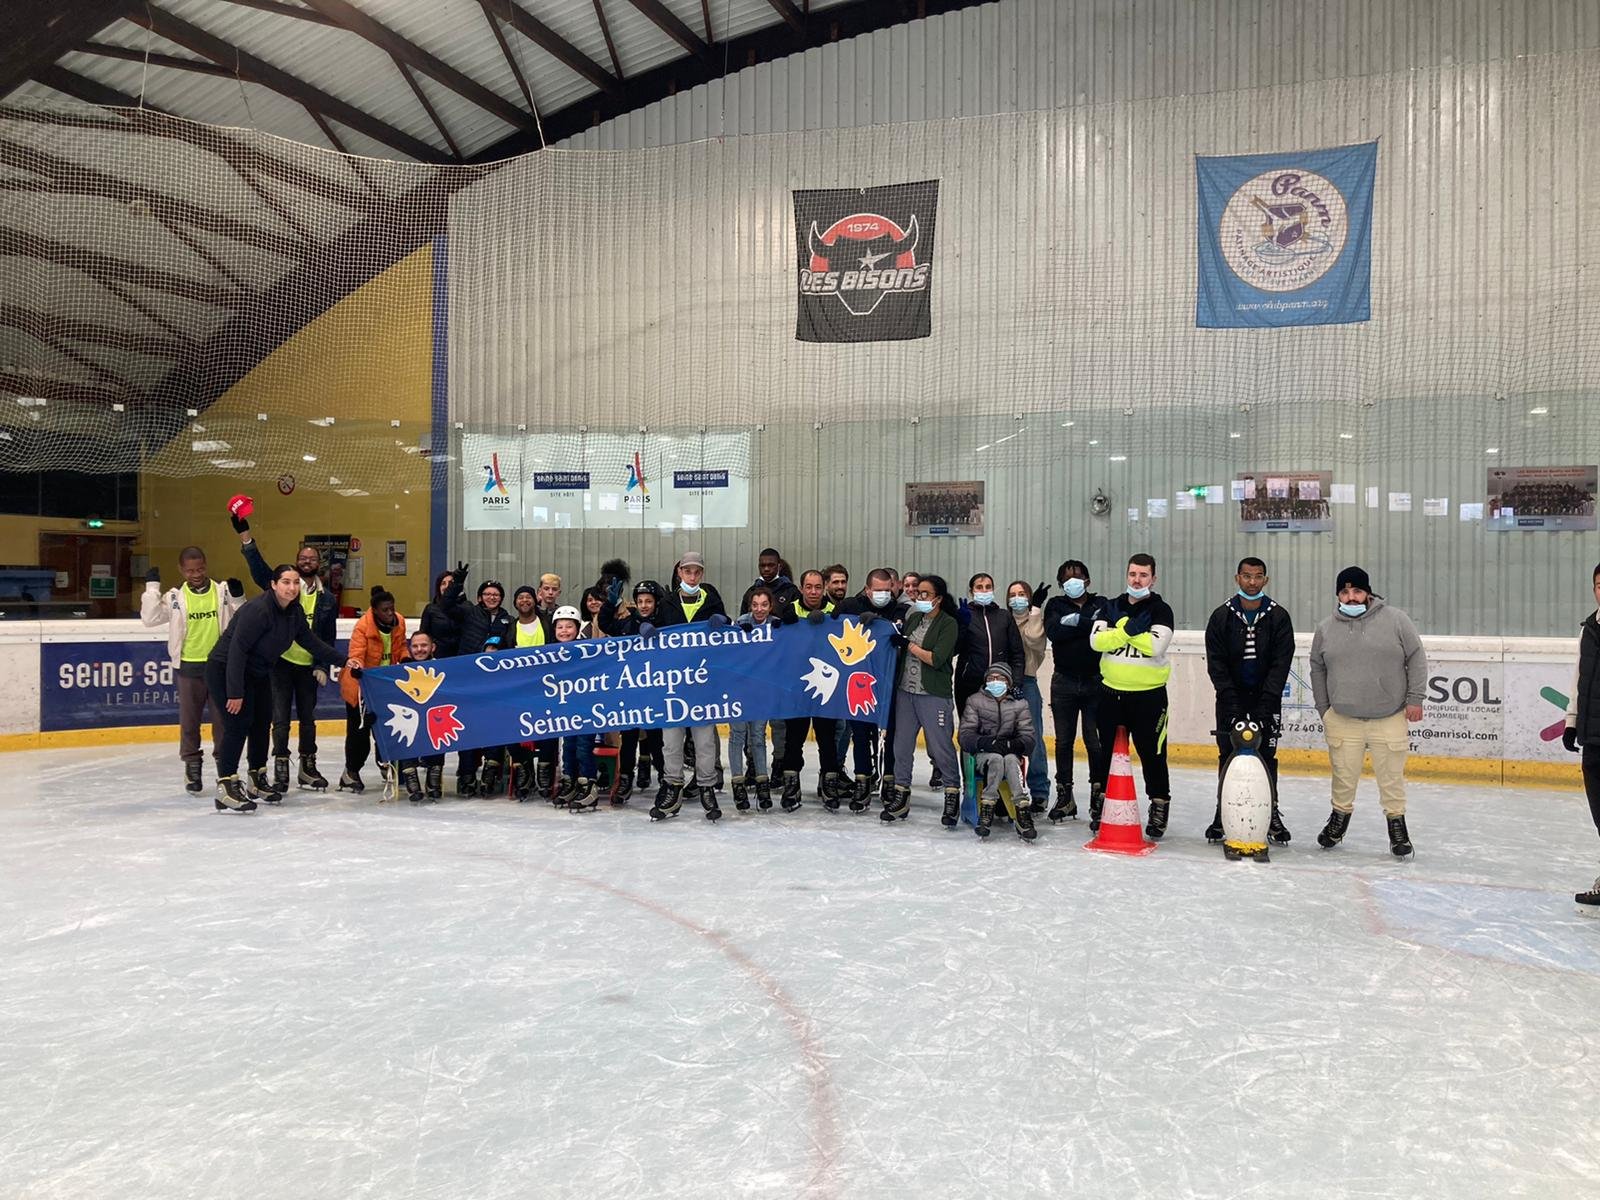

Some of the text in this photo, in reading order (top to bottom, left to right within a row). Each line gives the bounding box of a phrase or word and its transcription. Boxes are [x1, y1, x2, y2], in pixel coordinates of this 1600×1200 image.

[847, 222, 880, 233] 1974
[1260, 255, 1317, 278] ARTISTIQUE
[800, 270, 840, 292] LES
[482, 496, 510, 504] PARIS
[624, 495, 651, 503] PARIS
[475, 646, 572, 672] Comité
[59, 662, 133, 689] seine
[542, 658, 708, 704] Sport Adapté
[106, 692, 124, 705] LE
[519, 694, 743, 737] Seine-Saint-Denis
[1466, 706, 1501, 714] FLOCAGE
[1288, 723, 1300, 732] 72
[1302, 723, 1315, 733] 40
